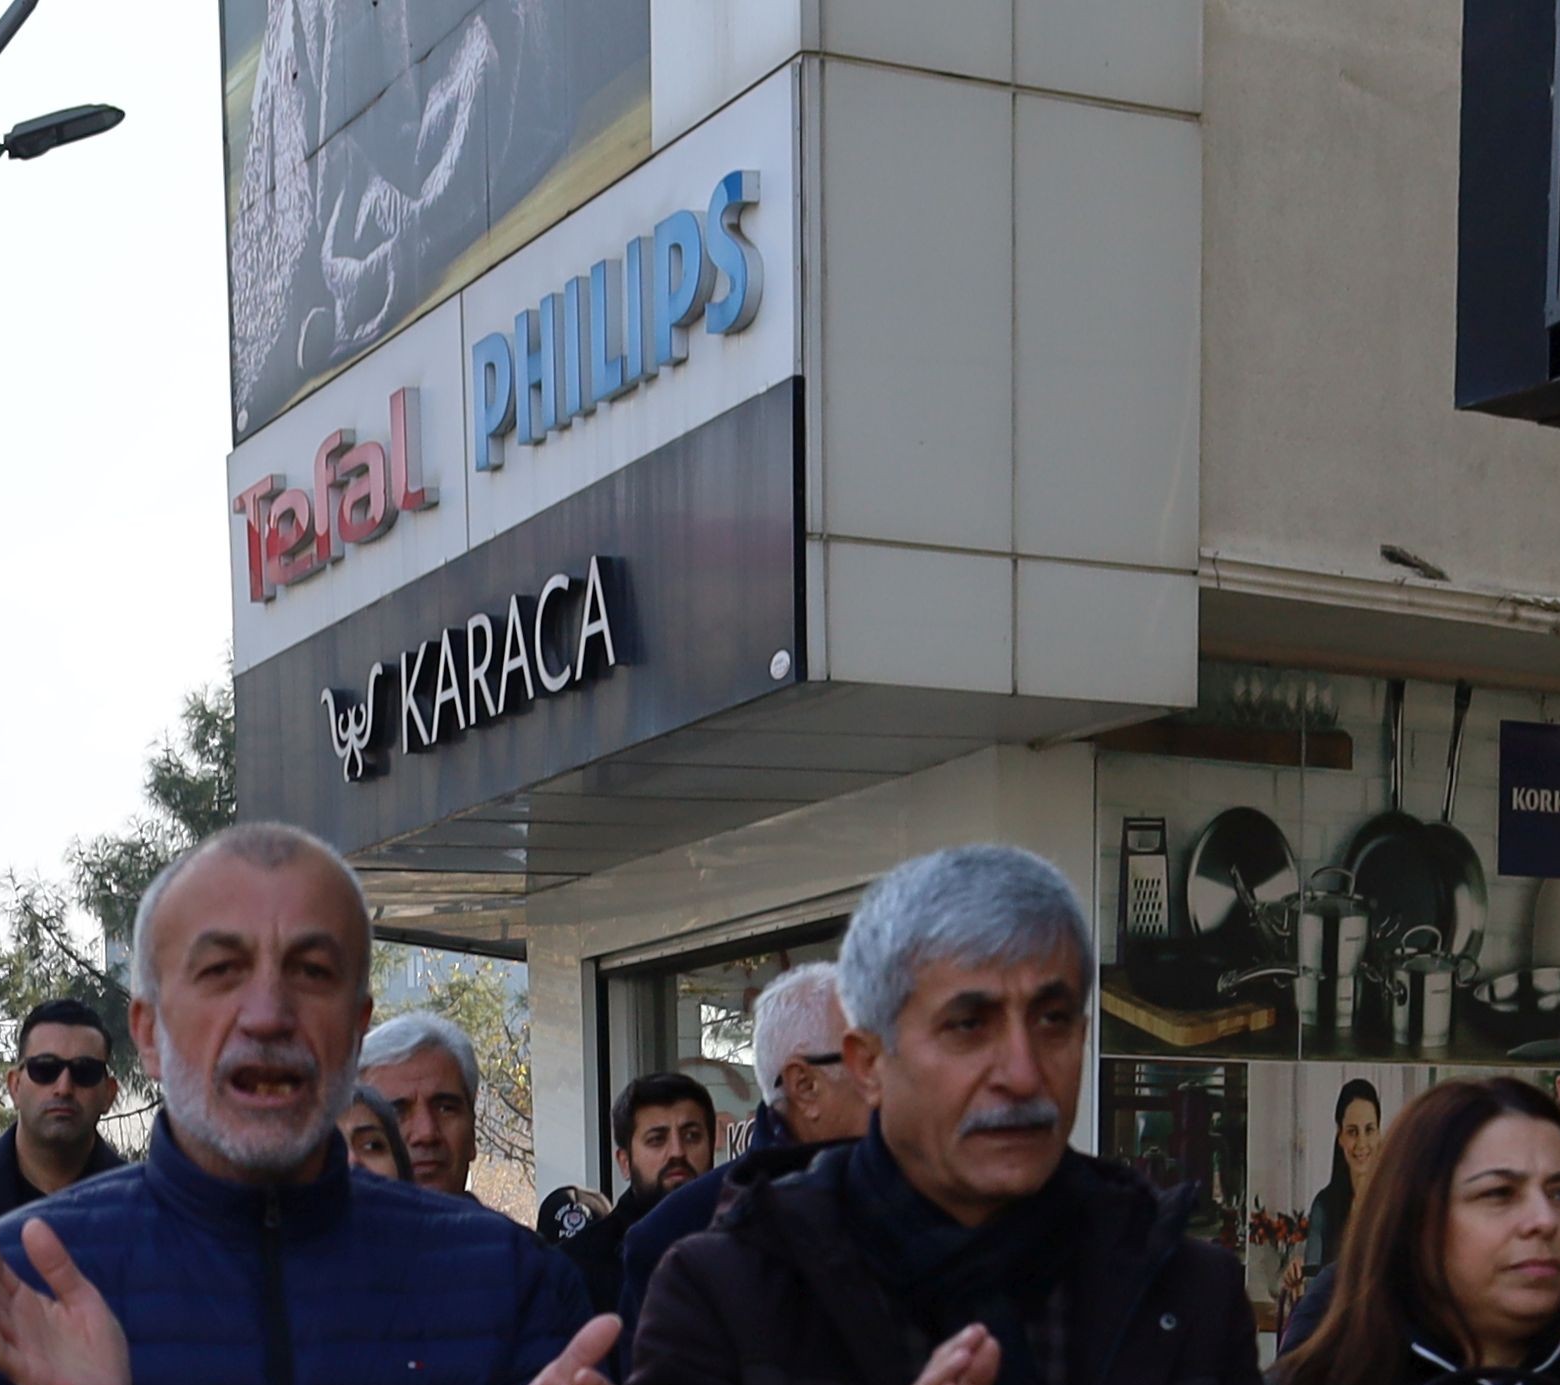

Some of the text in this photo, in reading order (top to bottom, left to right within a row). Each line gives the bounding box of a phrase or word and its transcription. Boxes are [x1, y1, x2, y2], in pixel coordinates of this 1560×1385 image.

[472, 169, 764, 472] PHILIPS
[234, 386, 440, 602] Tefal
[401, 554, 616, 754] KARACA
